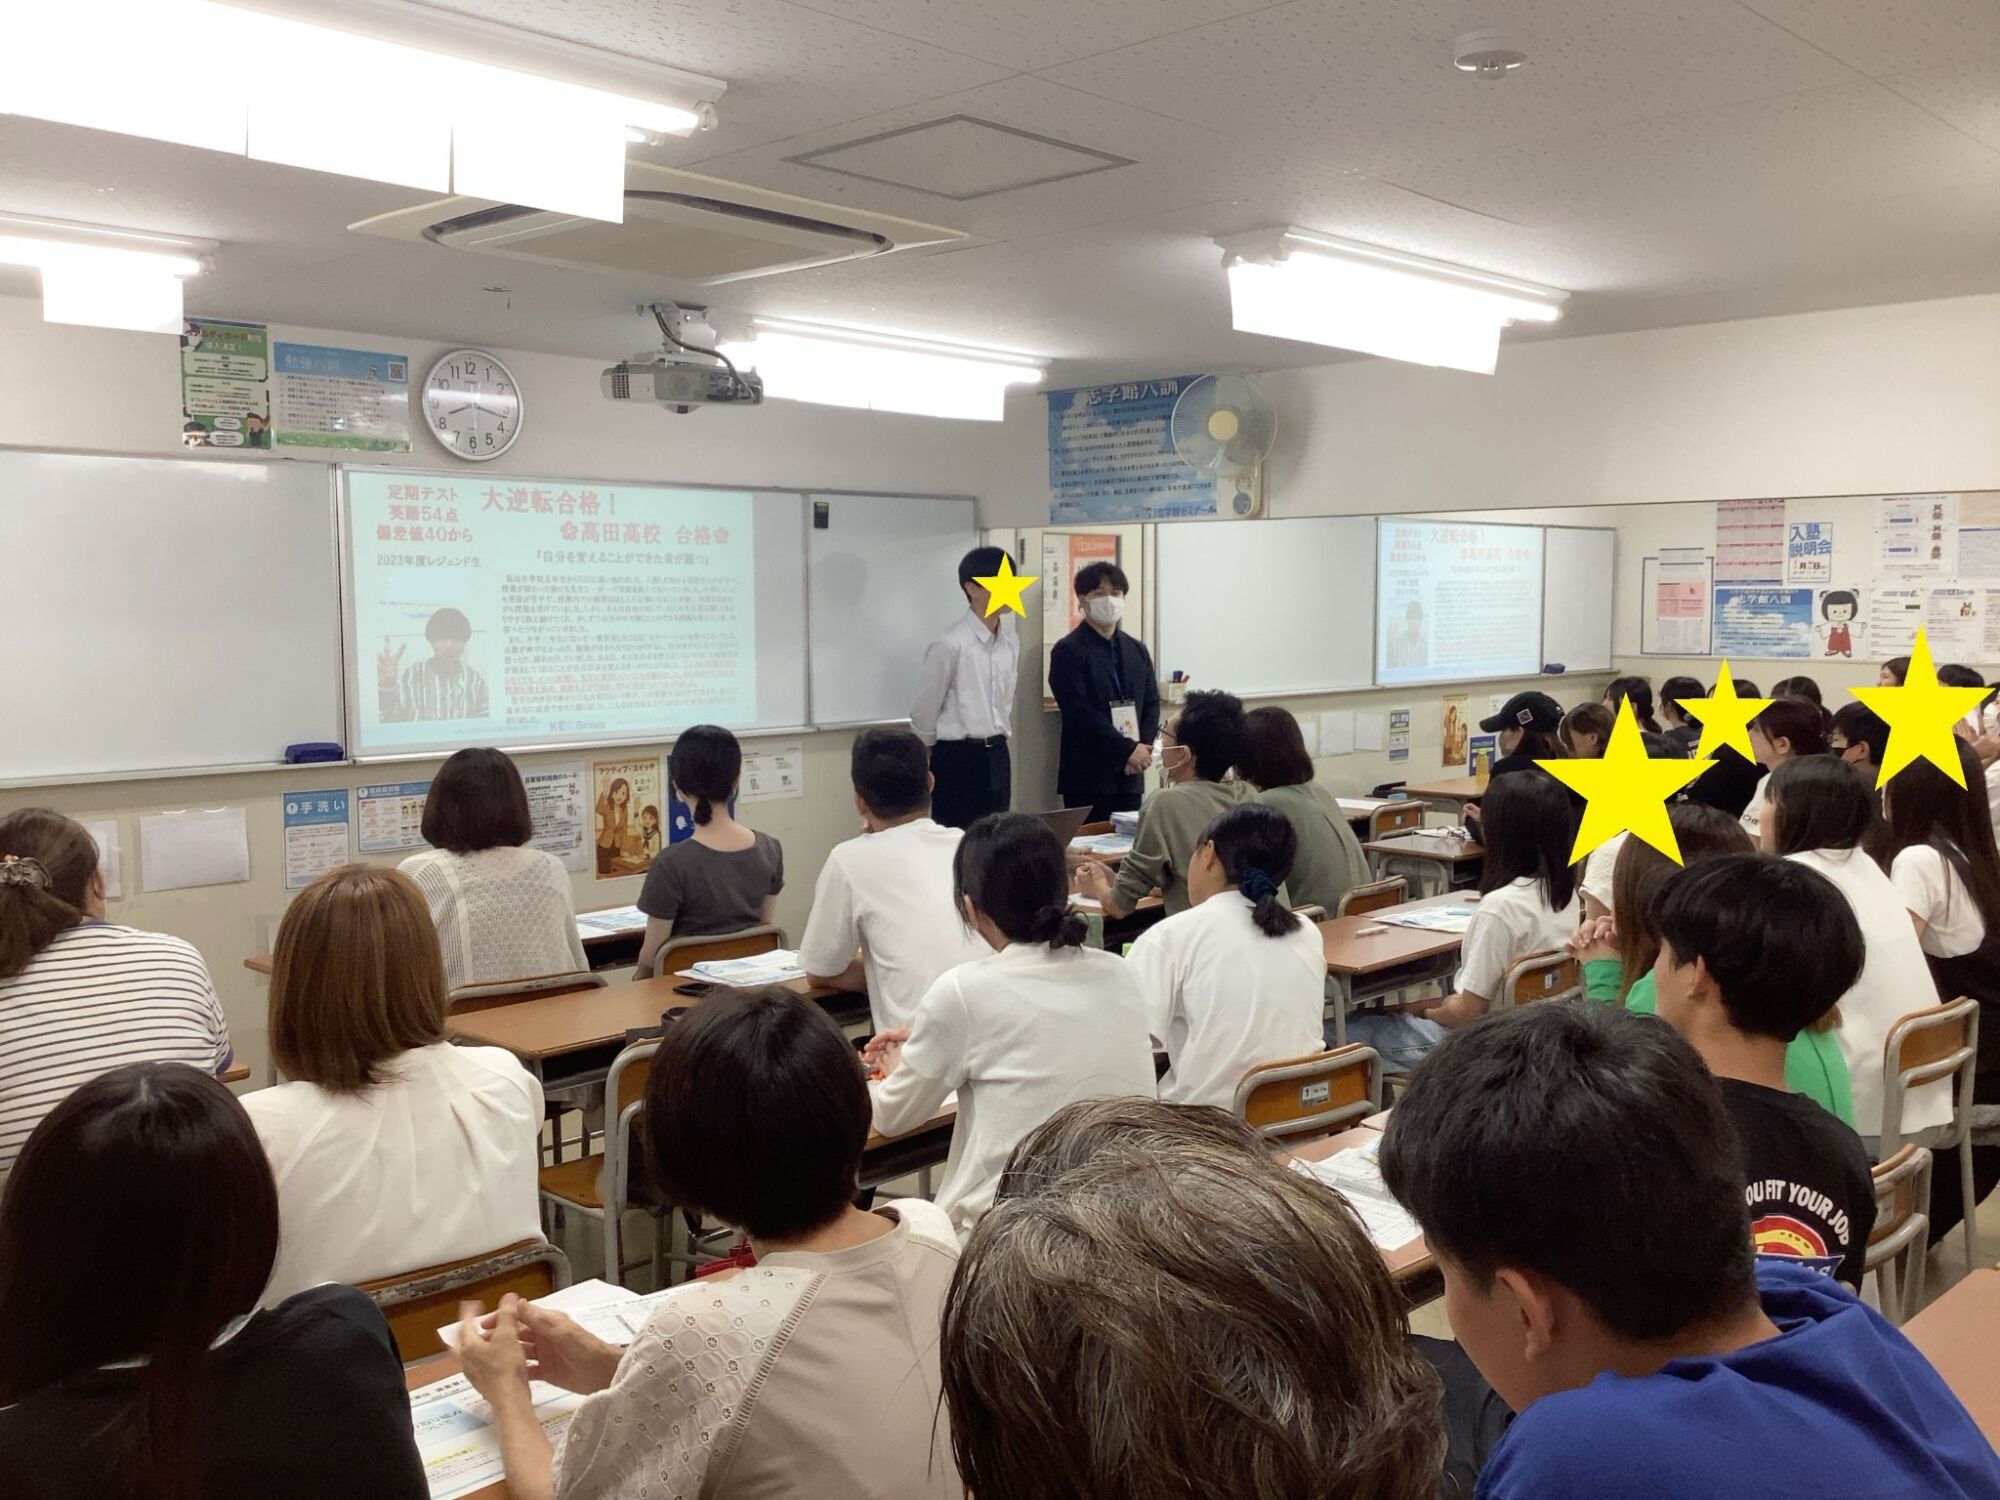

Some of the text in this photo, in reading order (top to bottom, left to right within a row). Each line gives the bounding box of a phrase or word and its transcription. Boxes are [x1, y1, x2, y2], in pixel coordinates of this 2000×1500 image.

[450, 365, 460, 379] 11
[464, 361, 476, 375] 12
[485, 368, 490, 381] 1
[438, 379, 449, 390] 10
[496, 383, 504, 395] 2
[439, 417, 447, 430] 8
[497, 421, 505, 434] 4
[453, 431, 461, 444] 7
[469, 436, 477, 449] 6
[485, 433, 493, 446] 5
[388, 484, 459, 502] 定期テスト
[480, 486, 617, 516] 大逆転合格！
[389, 505, 460, 523] 英語54点
[377, 524, 473, 543] 偏差値40から
[581, 522, 711, 545] 高田高校 合格
[1790, 523, 1821, 542] 入塾
[1790, 540, 1832, 558] 説明会
[377, 553, 482, 568] 2023年度レジェンド生
[301, 800, 346, 815] 手洗い
[1745, 1181, 1764, 1206] OU
[1765, 1179, 1787, 1200] FIT
[1788, 1182, 1834, 1219] YOUR
